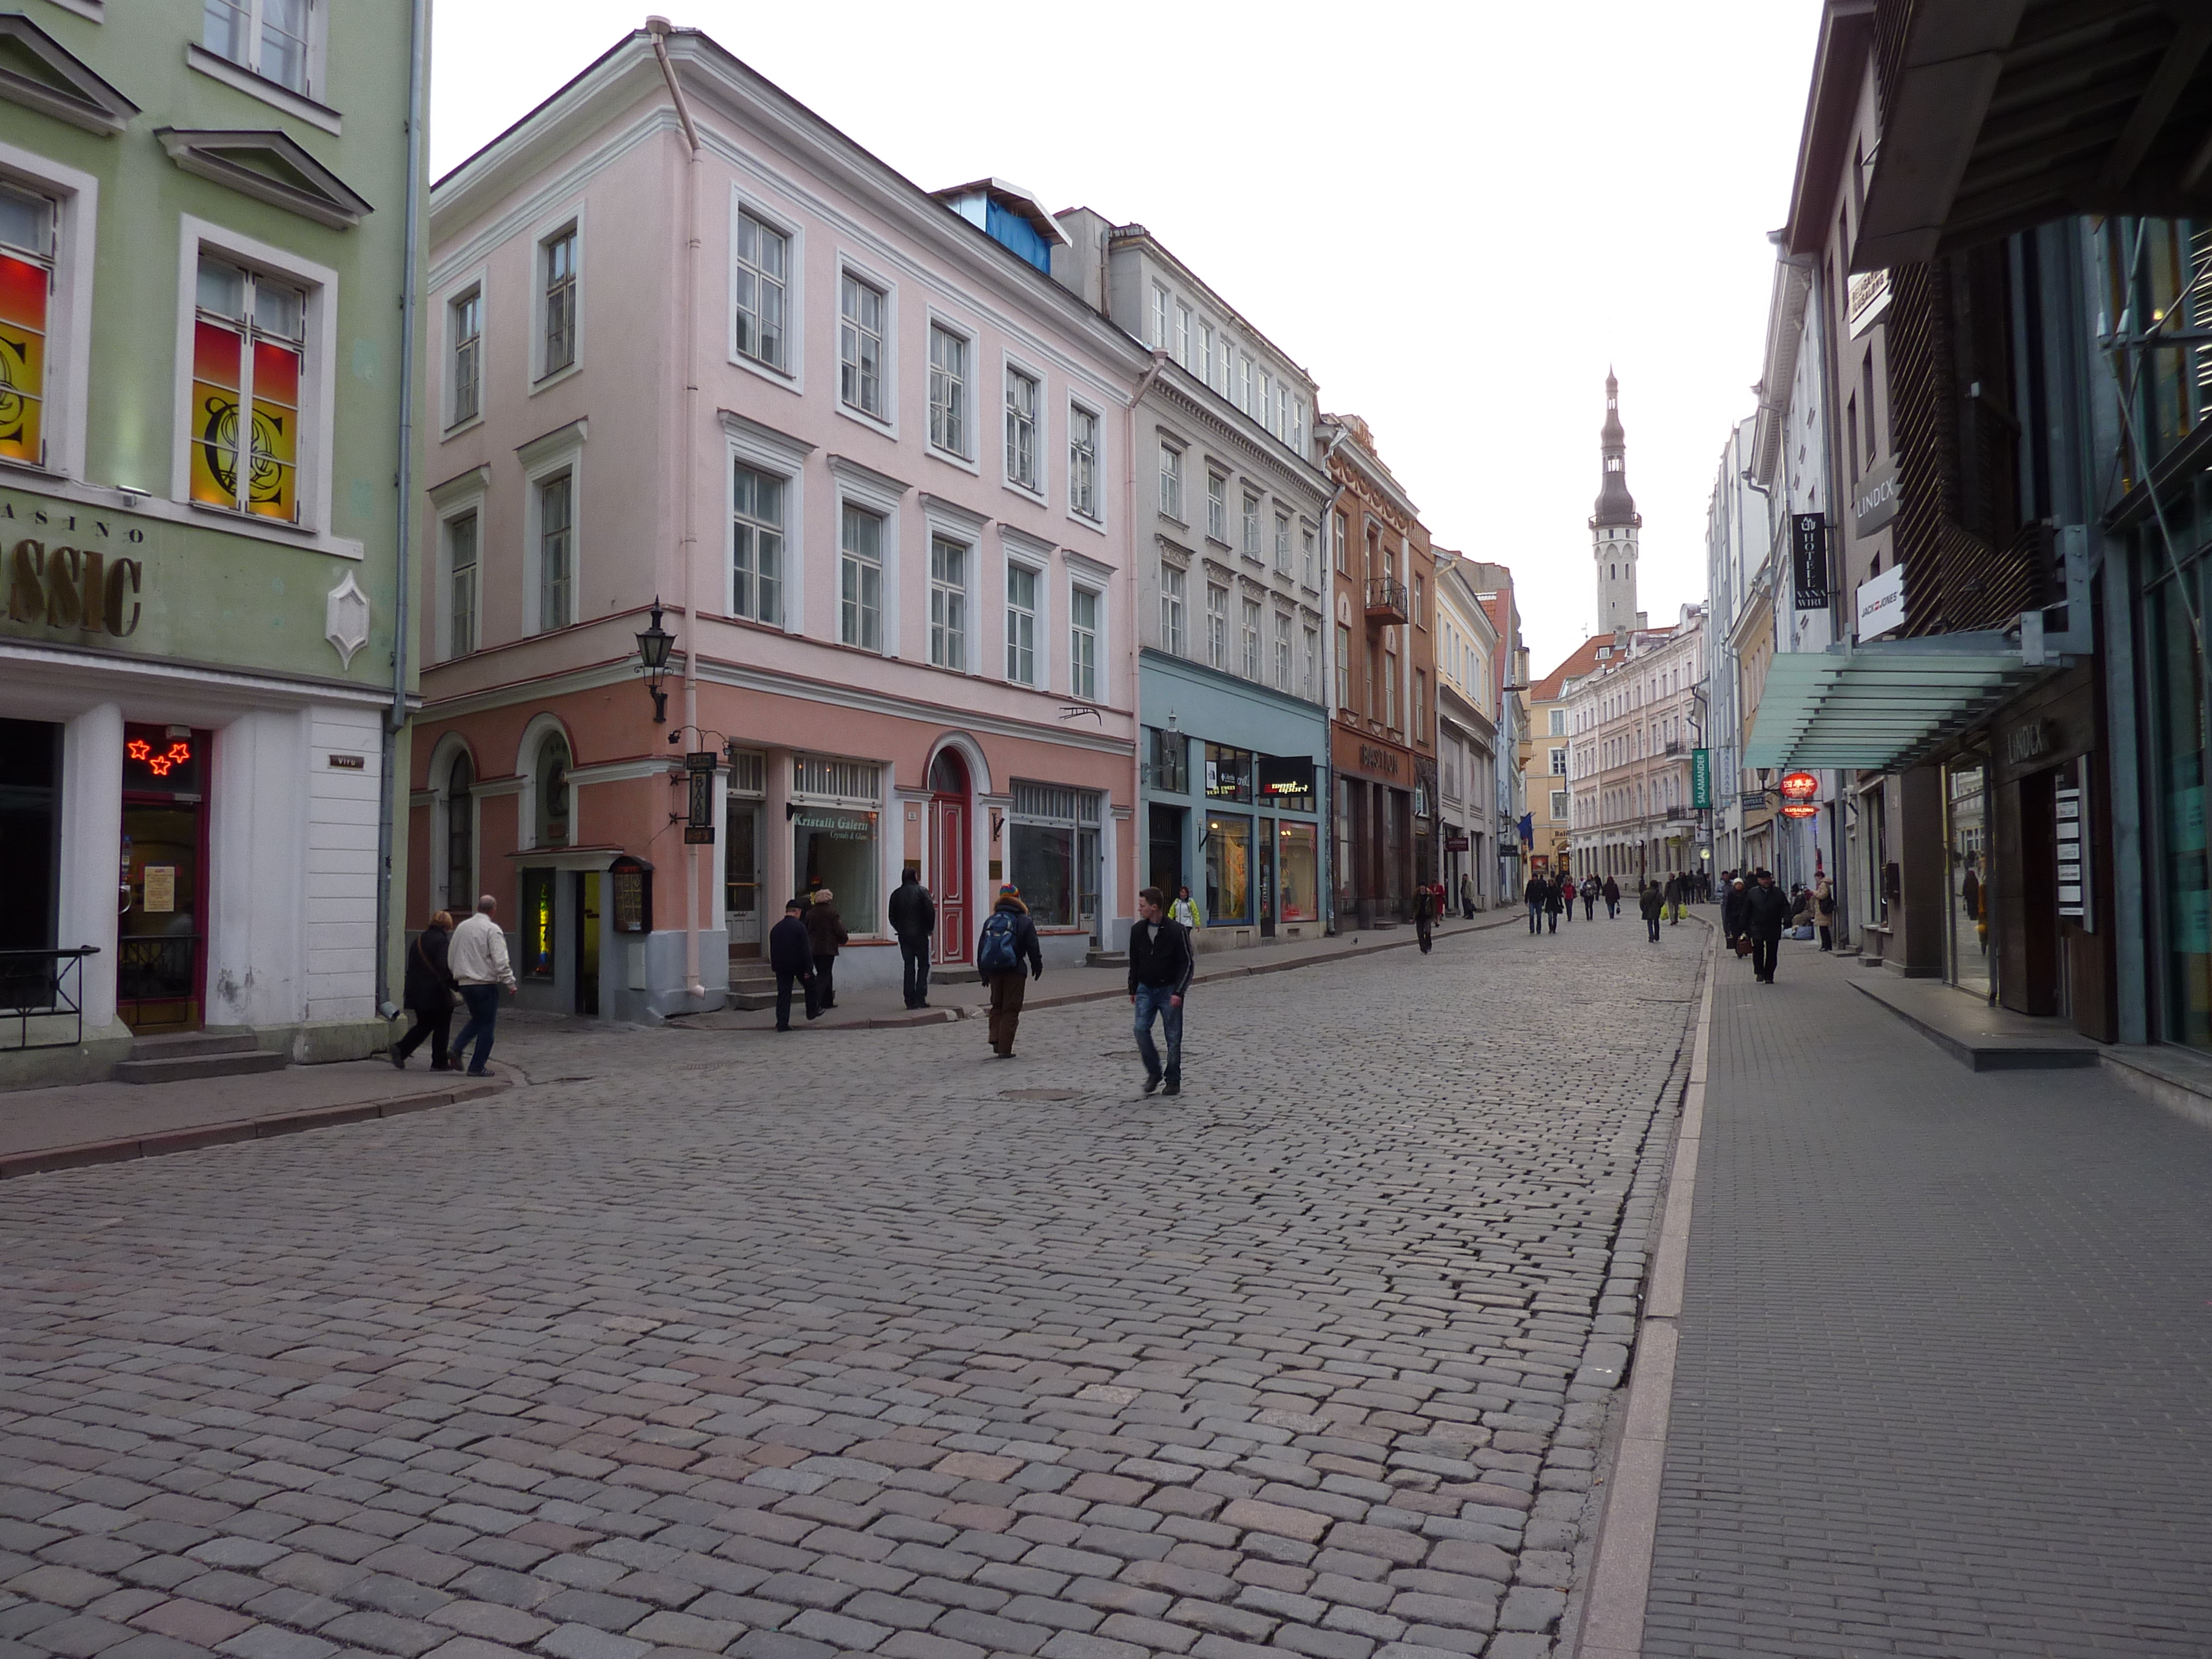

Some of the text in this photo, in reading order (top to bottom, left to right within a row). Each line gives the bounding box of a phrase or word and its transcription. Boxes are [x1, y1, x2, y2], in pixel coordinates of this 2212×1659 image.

[1805, 533, 1815, 588] HOTELL
[0, 538, 142, 637] SSIC
[1797, 590, 1826, 598] VANA
[338, 757, 356, 766] Viru
[1360, 743, 1398, 775] BASTION
